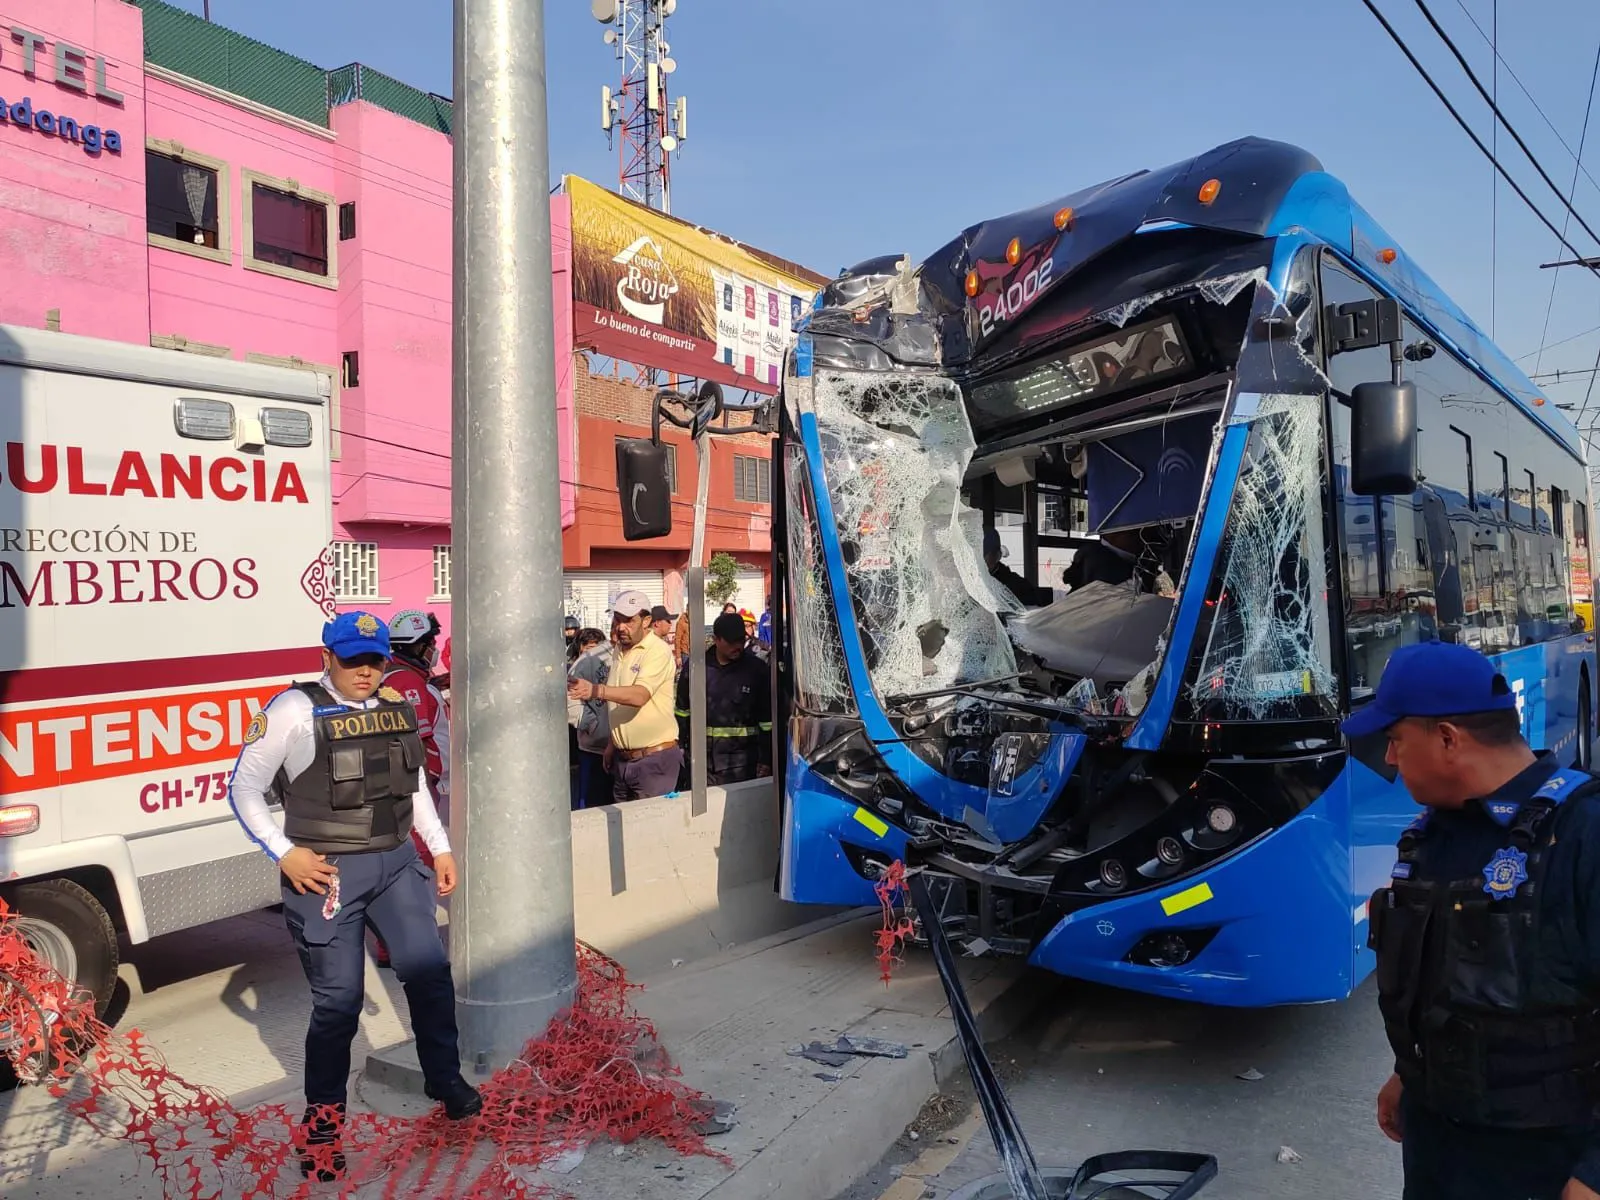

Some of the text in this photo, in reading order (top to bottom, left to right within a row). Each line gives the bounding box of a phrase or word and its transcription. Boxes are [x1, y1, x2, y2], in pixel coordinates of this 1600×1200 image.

[0, 26, 124, 104] TEL
[627, 265, 670, 301] Roja
[634, 254, 661, 271] casa
[979, 257, 1053, 337] 24002
[593, 310, 697, 352] Lo bueno de compartir
[0, 442, 309, 503] ULANCIA
[0, 524, 197, 553] RECCIÓN DE
[0, 558, 259, 607] MBEROS
[330, 711, 410, 739] POLICIA
[139, 770, 233, 814] CH-73
[1492, 805, 1514, 814] SSC
